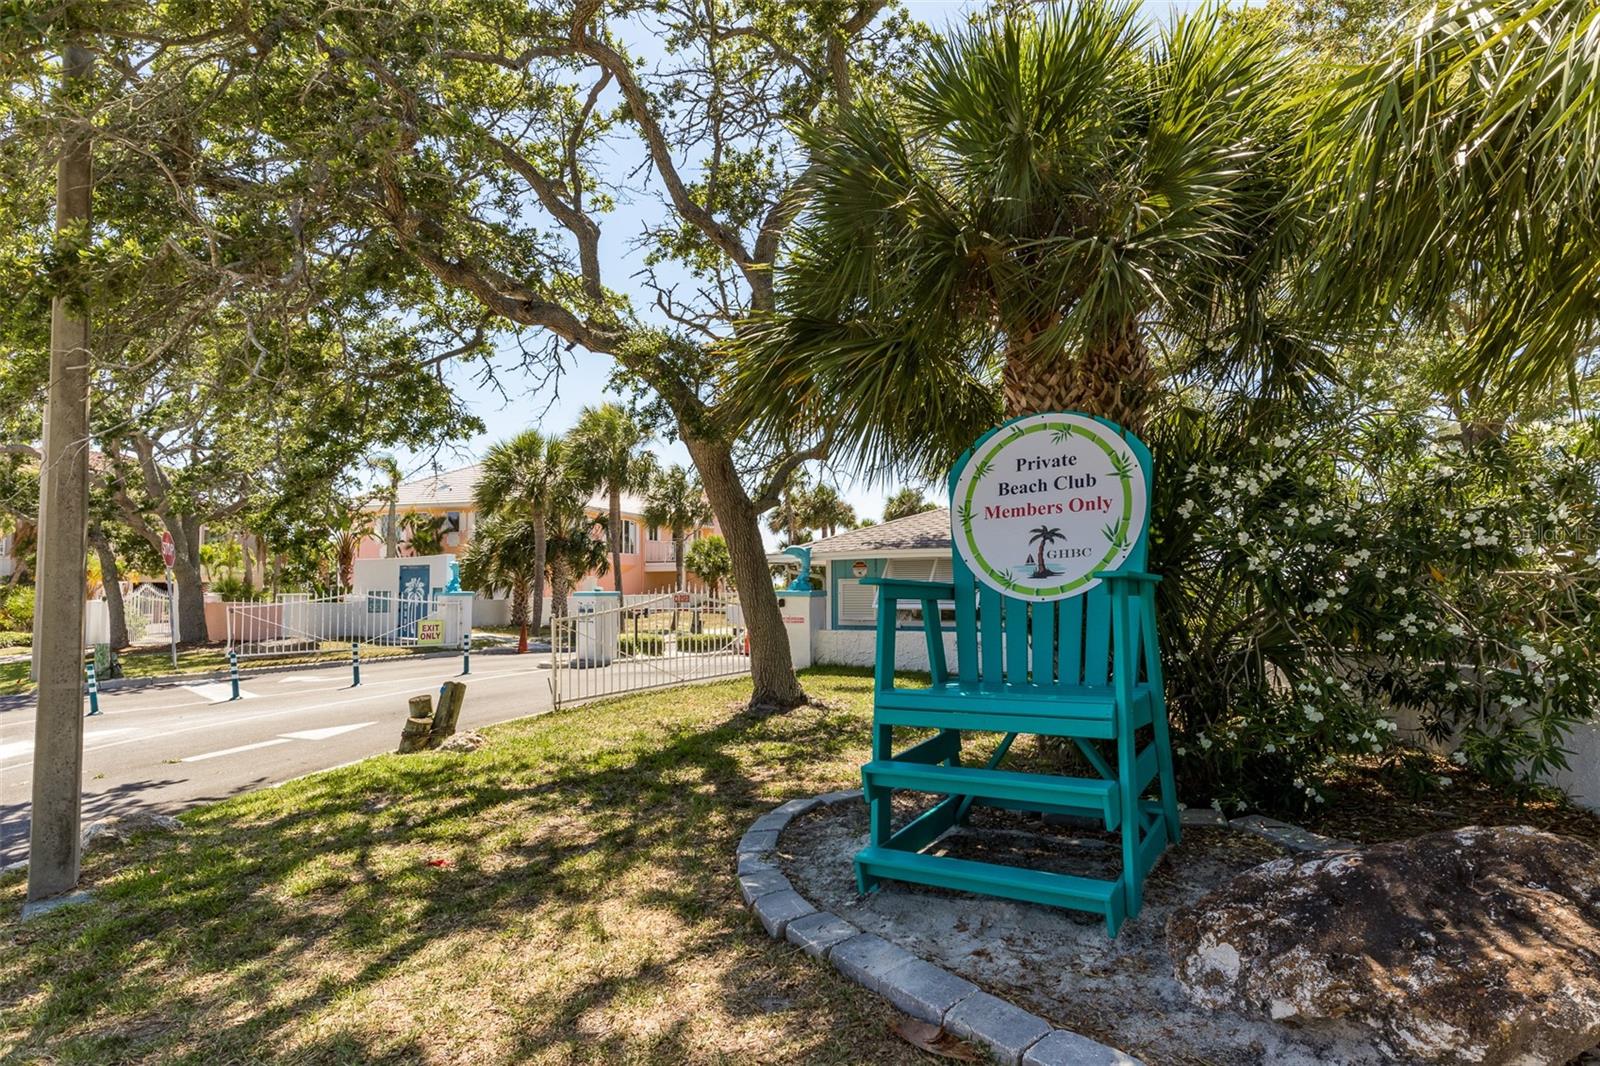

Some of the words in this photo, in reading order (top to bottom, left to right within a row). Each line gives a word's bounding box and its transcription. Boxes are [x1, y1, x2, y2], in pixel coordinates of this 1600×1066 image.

[1016, 454, 1077, 472] Private
[998, 478, 1047, 497] Beach
[1053, 473, 1097, 491] Club
[984, 502, 1063, 520] Members
[1068, 496, 1113, 514] Only
[161, 542, 175, 555] STOP
[1046, 547, 1092, 559] GHBC
[420, 632, 441, 640] ONLY
